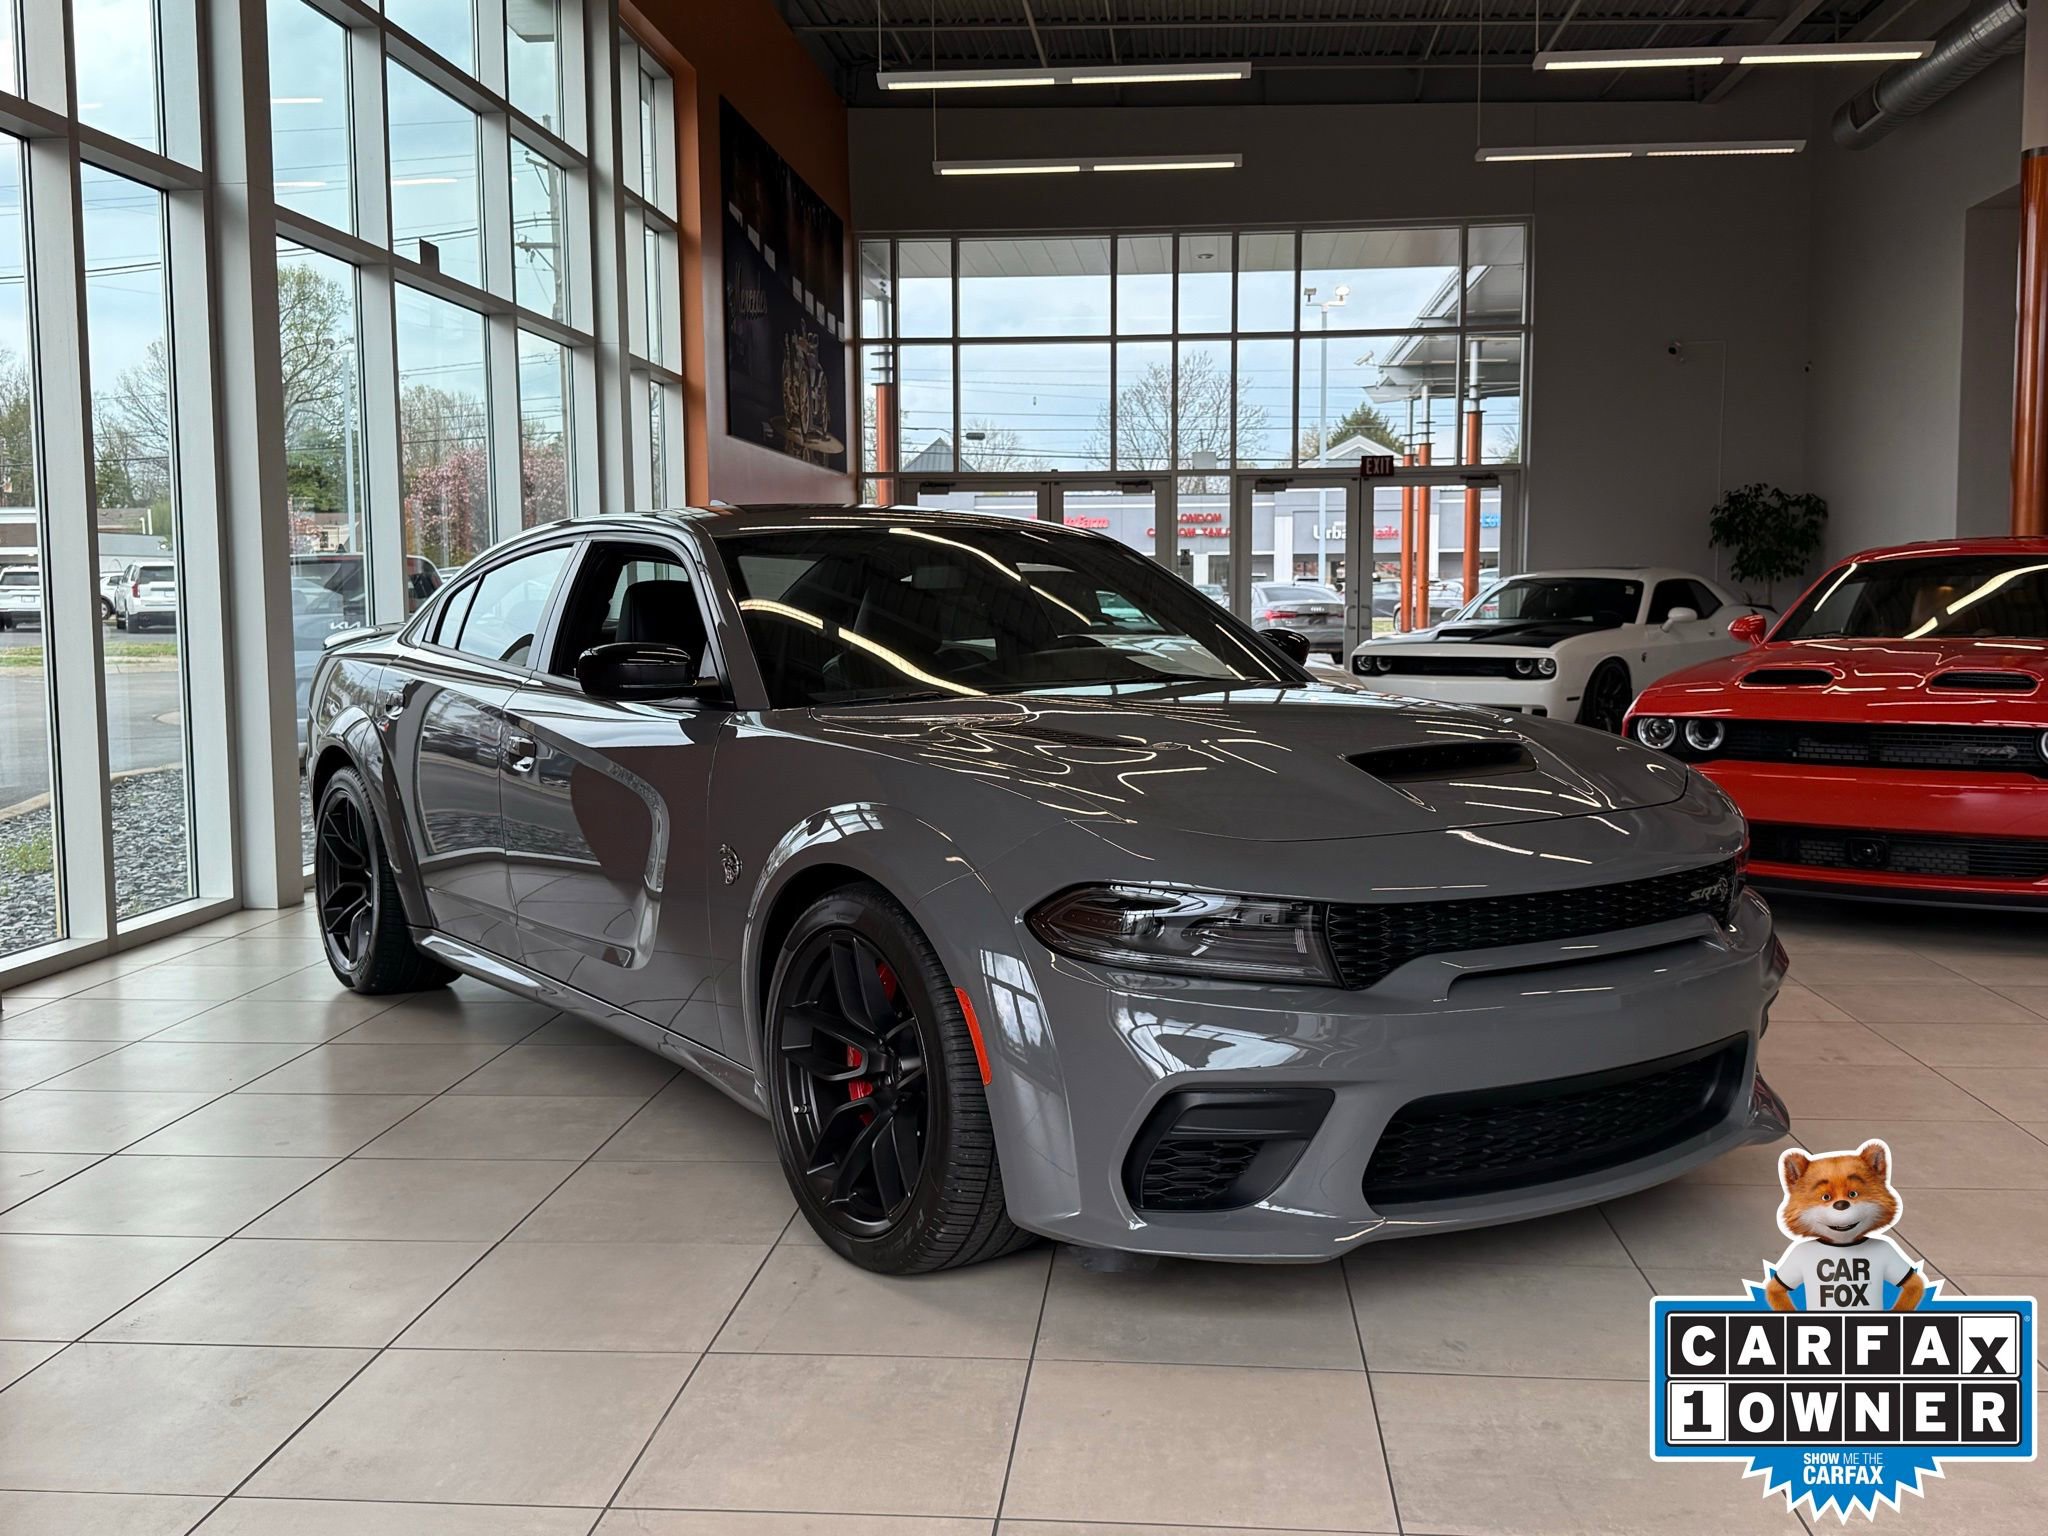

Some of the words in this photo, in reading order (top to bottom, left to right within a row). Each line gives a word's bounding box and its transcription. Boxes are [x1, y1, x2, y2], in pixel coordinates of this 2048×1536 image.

[1366, 458, 1391, 475] EXIT
[1178, 513, 1222, 523] ONDON
[1688, 884, 1719, 902] SRT
